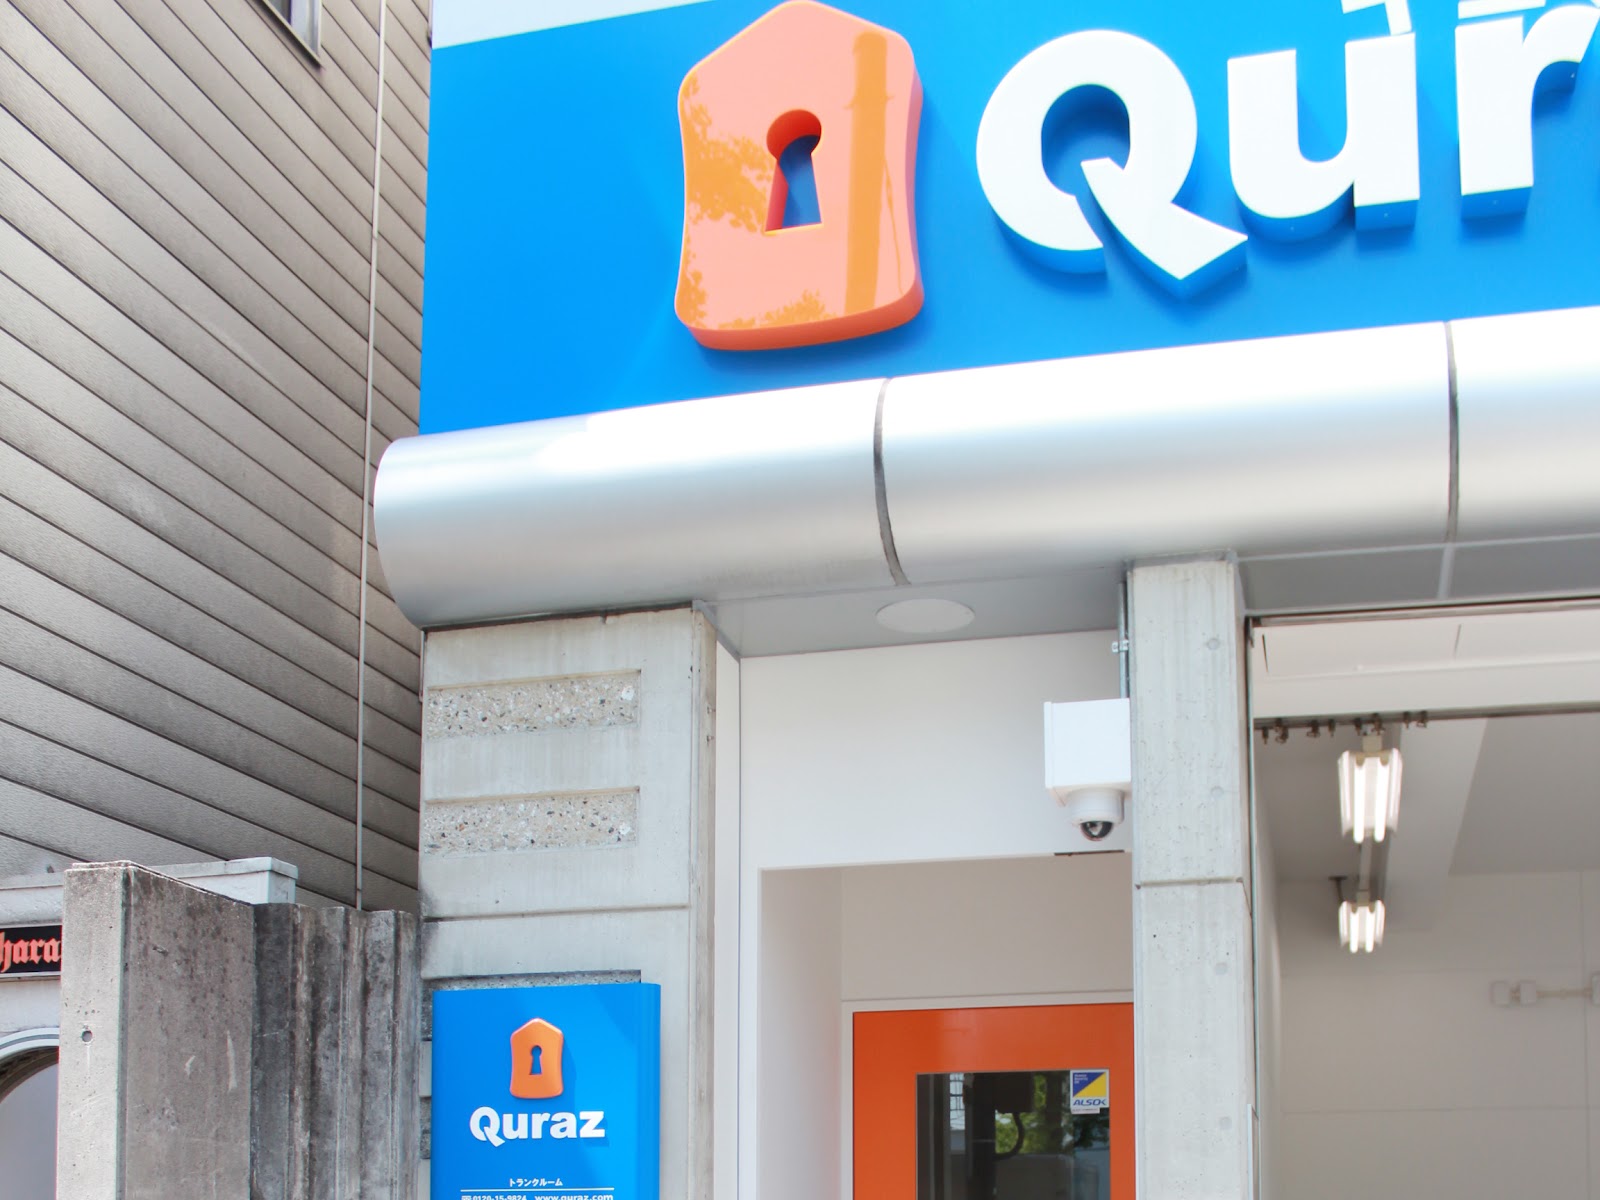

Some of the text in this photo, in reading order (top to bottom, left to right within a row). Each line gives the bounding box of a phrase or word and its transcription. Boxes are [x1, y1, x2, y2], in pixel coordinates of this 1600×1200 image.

[976, 5, 1600, 282] Qur
[469, 1106, 606, 1148] Quraz
[509, 1178, 564, 1188] トランクルーム
